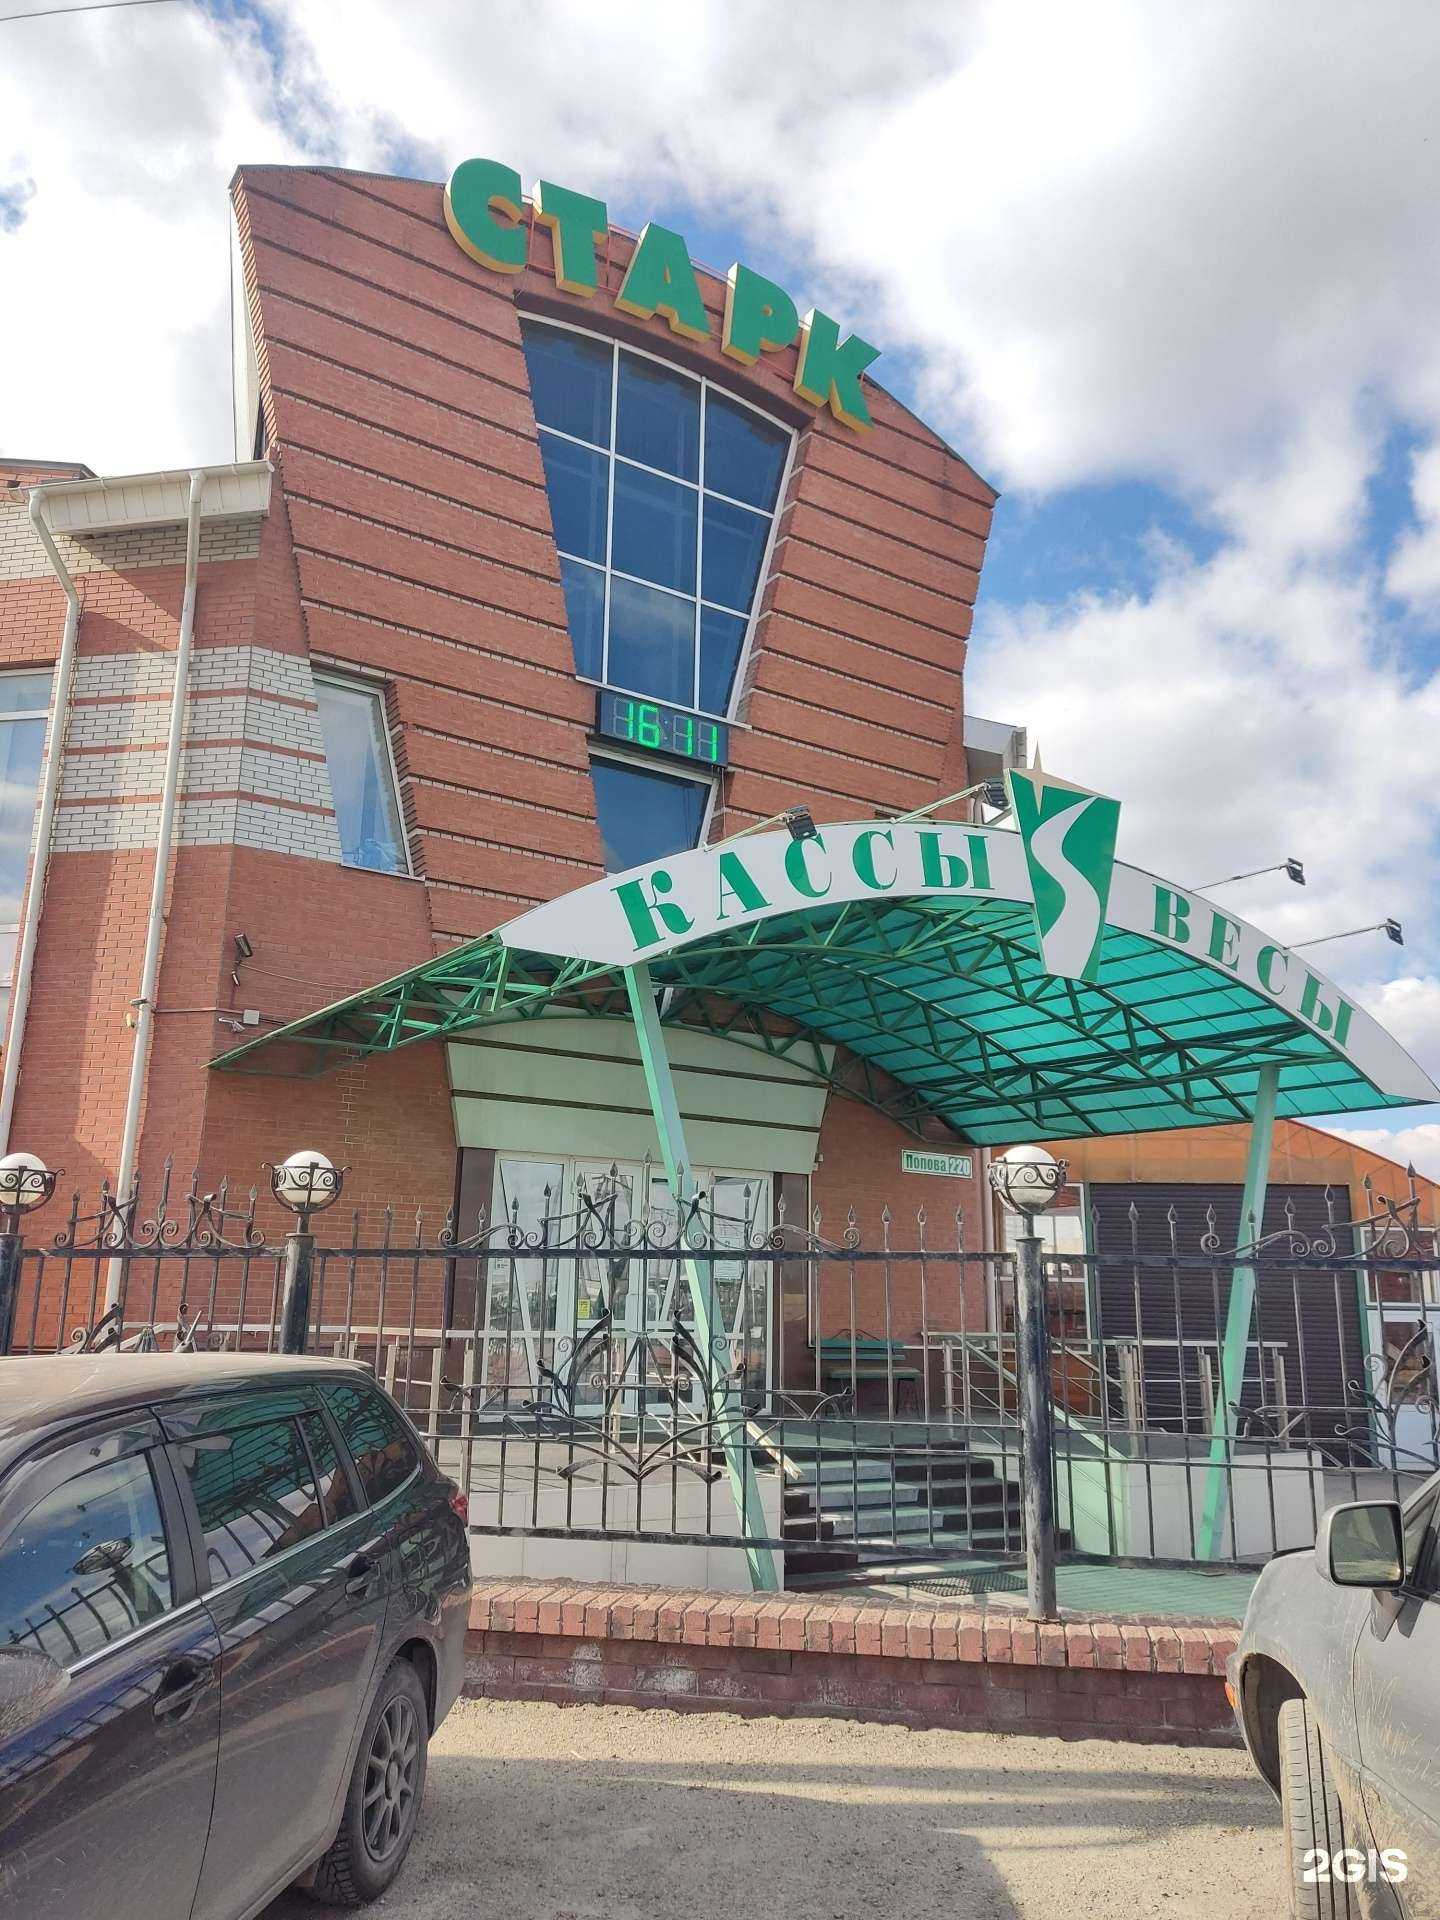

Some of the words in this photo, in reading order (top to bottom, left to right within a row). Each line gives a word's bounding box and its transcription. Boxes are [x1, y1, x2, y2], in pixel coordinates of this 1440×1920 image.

[443, 157, 882, 433] СТАРК
[610, 830, 995, 951] КАССЫ
[1151, 883, 1357, 1051] ВЕСЫ
[905, 1154, 947, 1172] Попова
